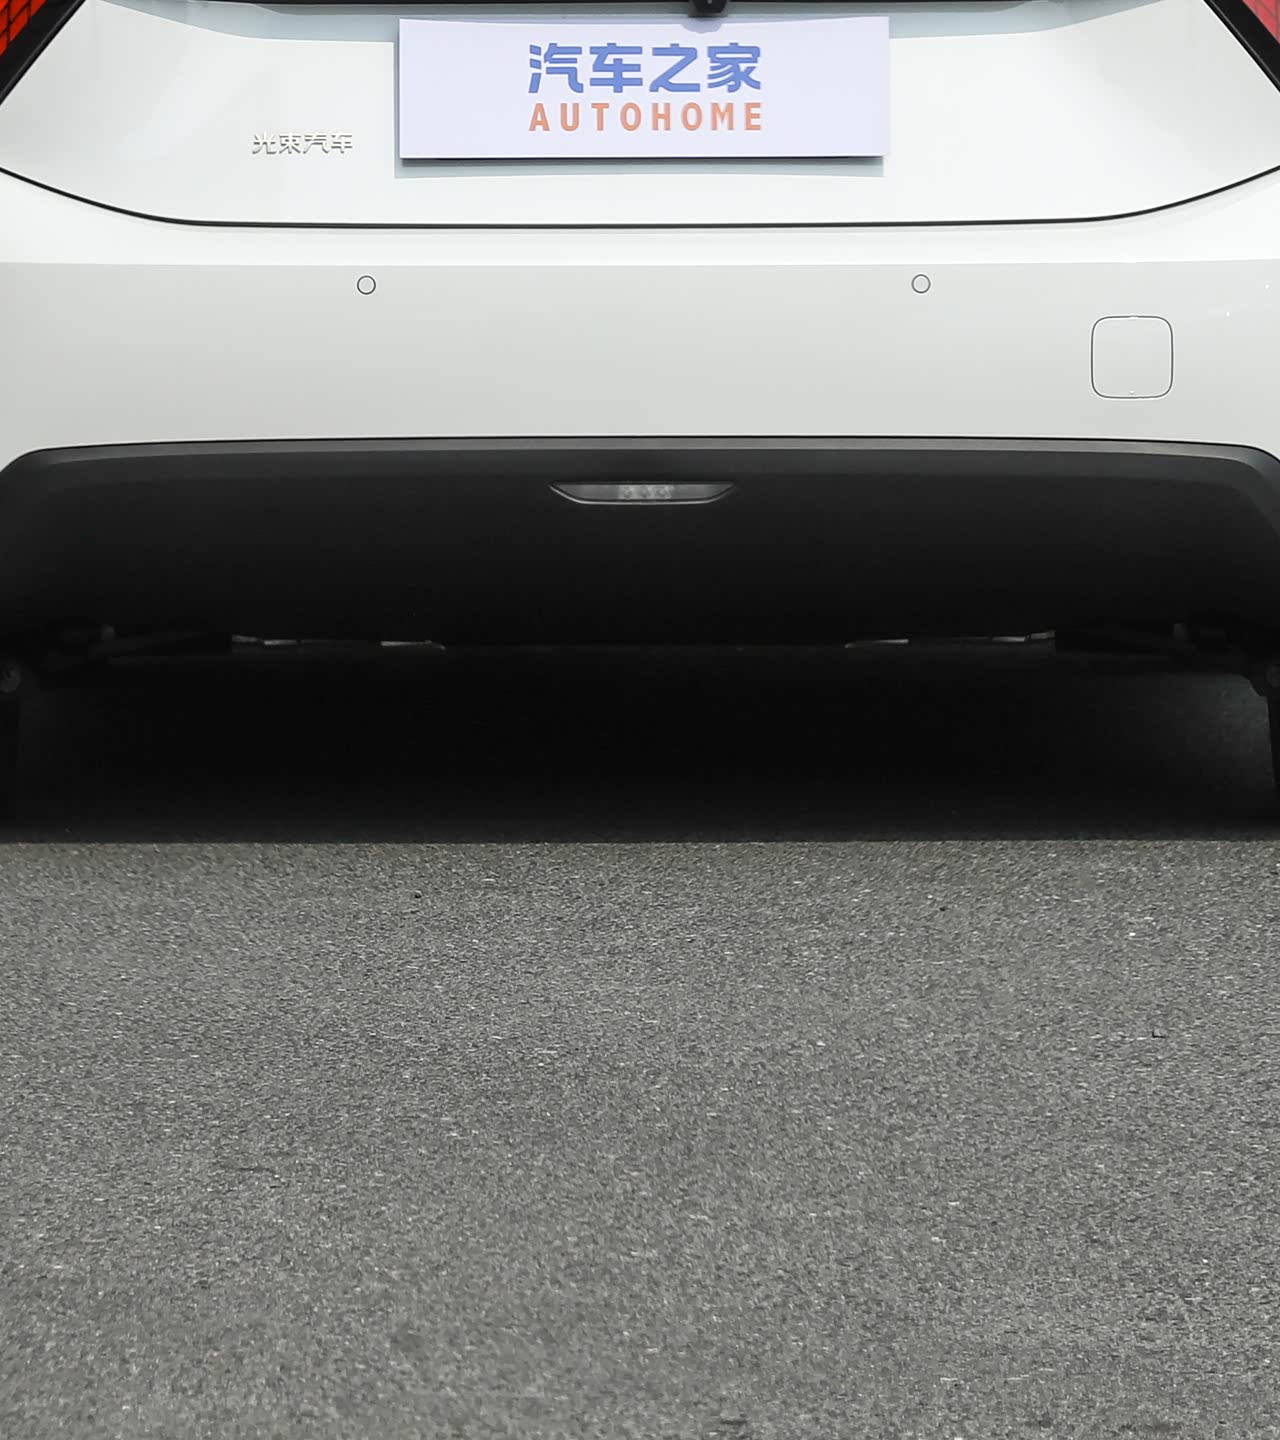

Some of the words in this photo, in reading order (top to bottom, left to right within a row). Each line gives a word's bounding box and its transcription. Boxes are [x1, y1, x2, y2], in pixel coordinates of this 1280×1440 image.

[528, 42, 762, 94] 汽车之家
[528, 102, 762, 132] AUTOHOME
[251, 131, 353, 155] 光束汽车
